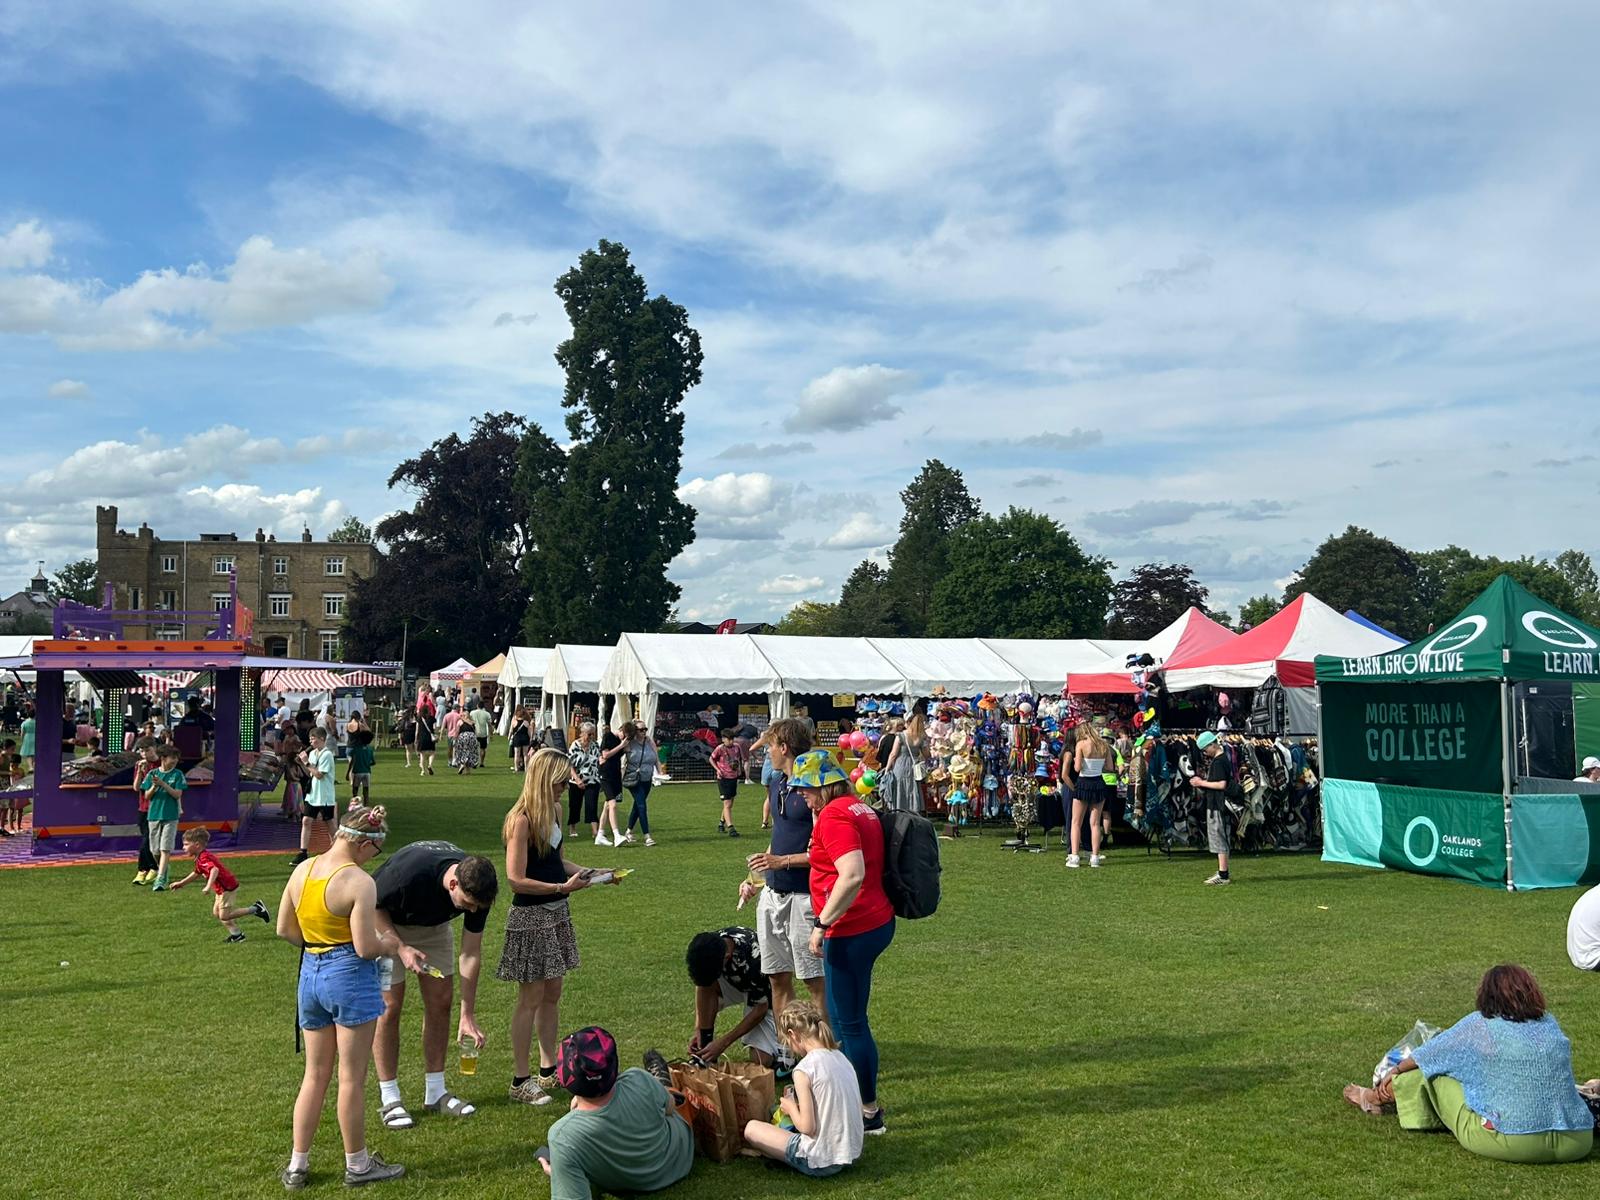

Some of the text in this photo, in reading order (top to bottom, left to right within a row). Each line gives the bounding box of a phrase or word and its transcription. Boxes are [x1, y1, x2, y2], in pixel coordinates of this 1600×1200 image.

[1341, 652, 1465, 676] LEARN.GROW.LIVE
[1542, 651, 1600, 674] LEARN.
[1365, 702, 1465, 724] MORE THAN A
[1365, 727, 1467, 762] COLLEGE
[1441, 846, 1475, 858] COLLEGE
[1442, 834, 1482, 848] OAKLANDS
